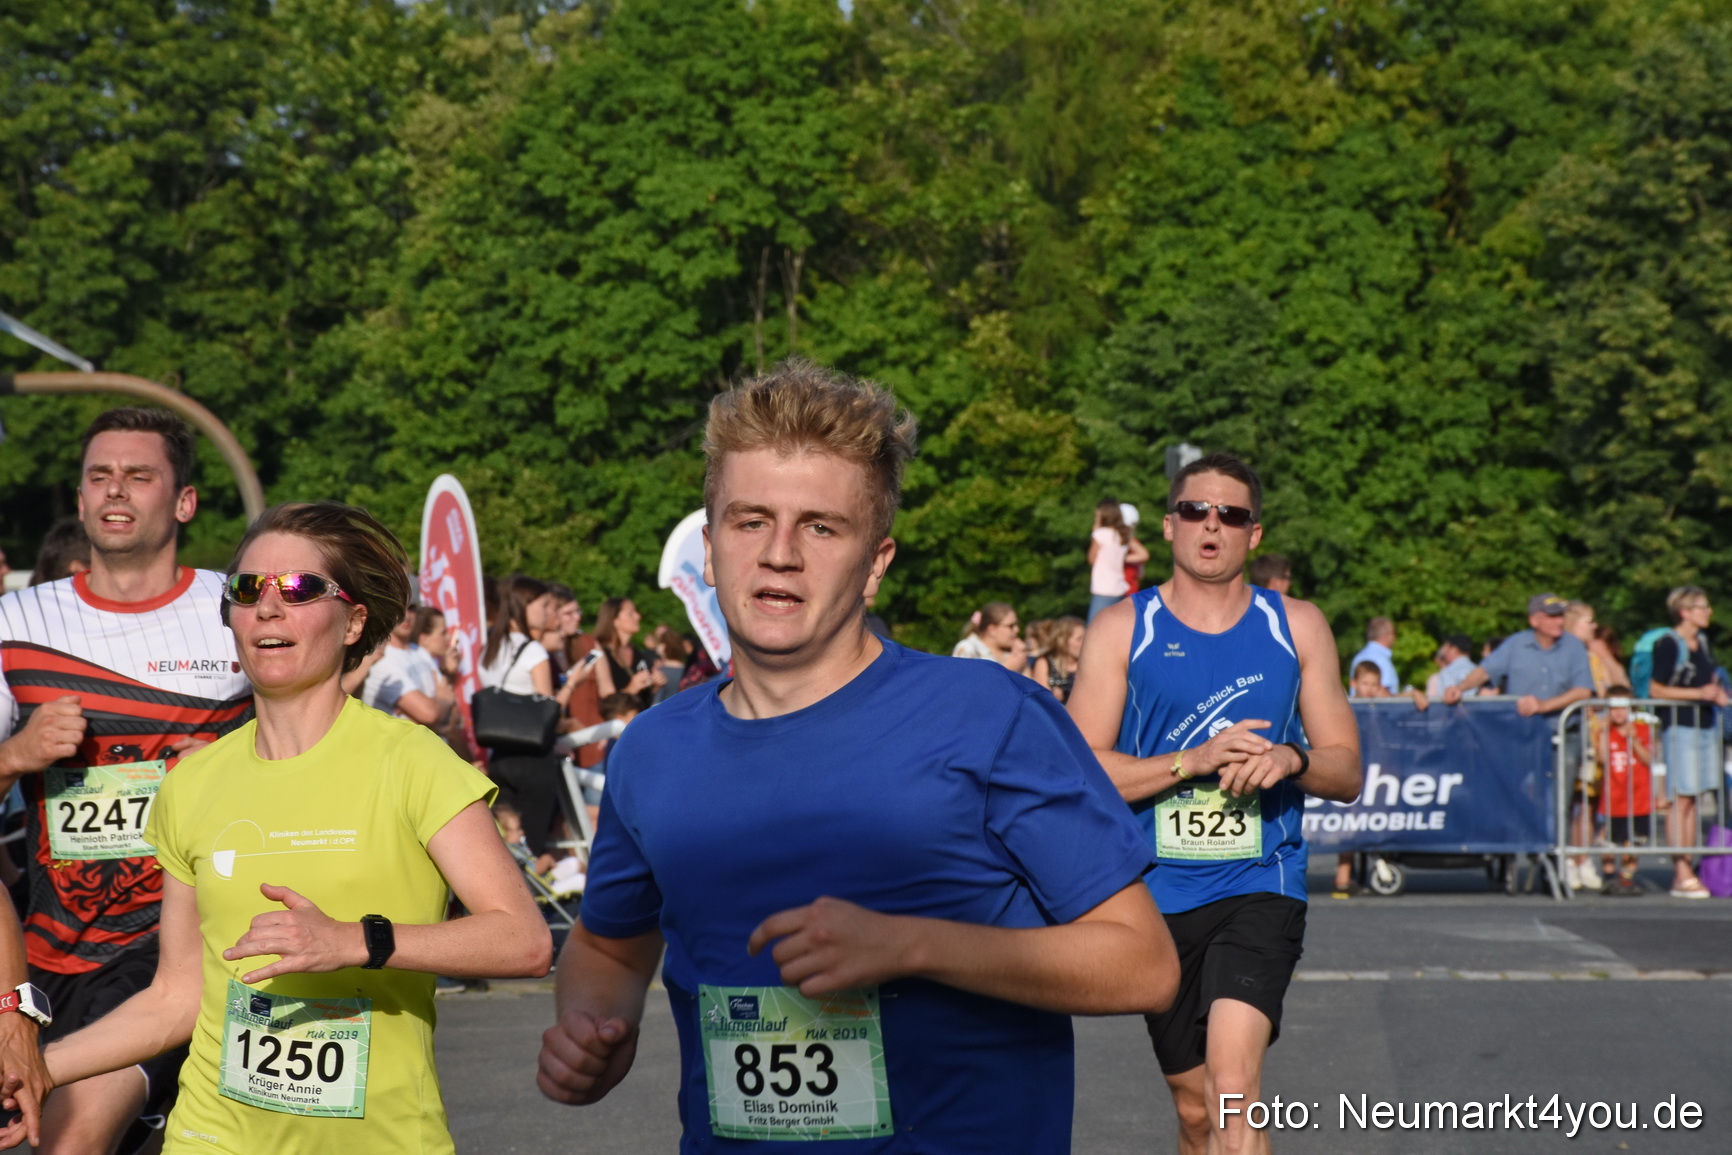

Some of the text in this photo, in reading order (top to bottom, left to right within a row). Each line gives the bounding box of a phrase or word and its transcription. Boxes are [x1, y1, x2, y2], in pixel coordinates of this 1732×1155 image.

[147, 660, 228, 673] NEUMARKT
[1166, 673, 1264, 742] Team Schick Bau
[59, 796, 150, 833] 2247
[1169, 809, 1246, 837] 1523
[70, 832, 144, 843] Heinloth Patrick
[269, 829, 357, 838] Kliniken des Landkreises
[290, 838, 327, 847] Neumarkt
[1181, 838, 1235, 846] Braun Roland
[241, 1007, 294, 1030] firmenlauf
[720, 1016, 789, 1032] firmenlauf
[329, 1030, 358, 1040] 2019
[832, 1027, 868, 1040] 2019
[237, 1028, 344, 1083] 1250
[734, 1043, 839, 1097] 853
[248, 1074, 322, 1095] Krüger Annie
[248, 1086, 279, 1099] Klinikum
[281, 1092, 320, 1105] Neumarkt
[743, 1099, 839, 1114] Elias Dominik
[748, 1116, 835, 1128] Fritz Berger GmbH
